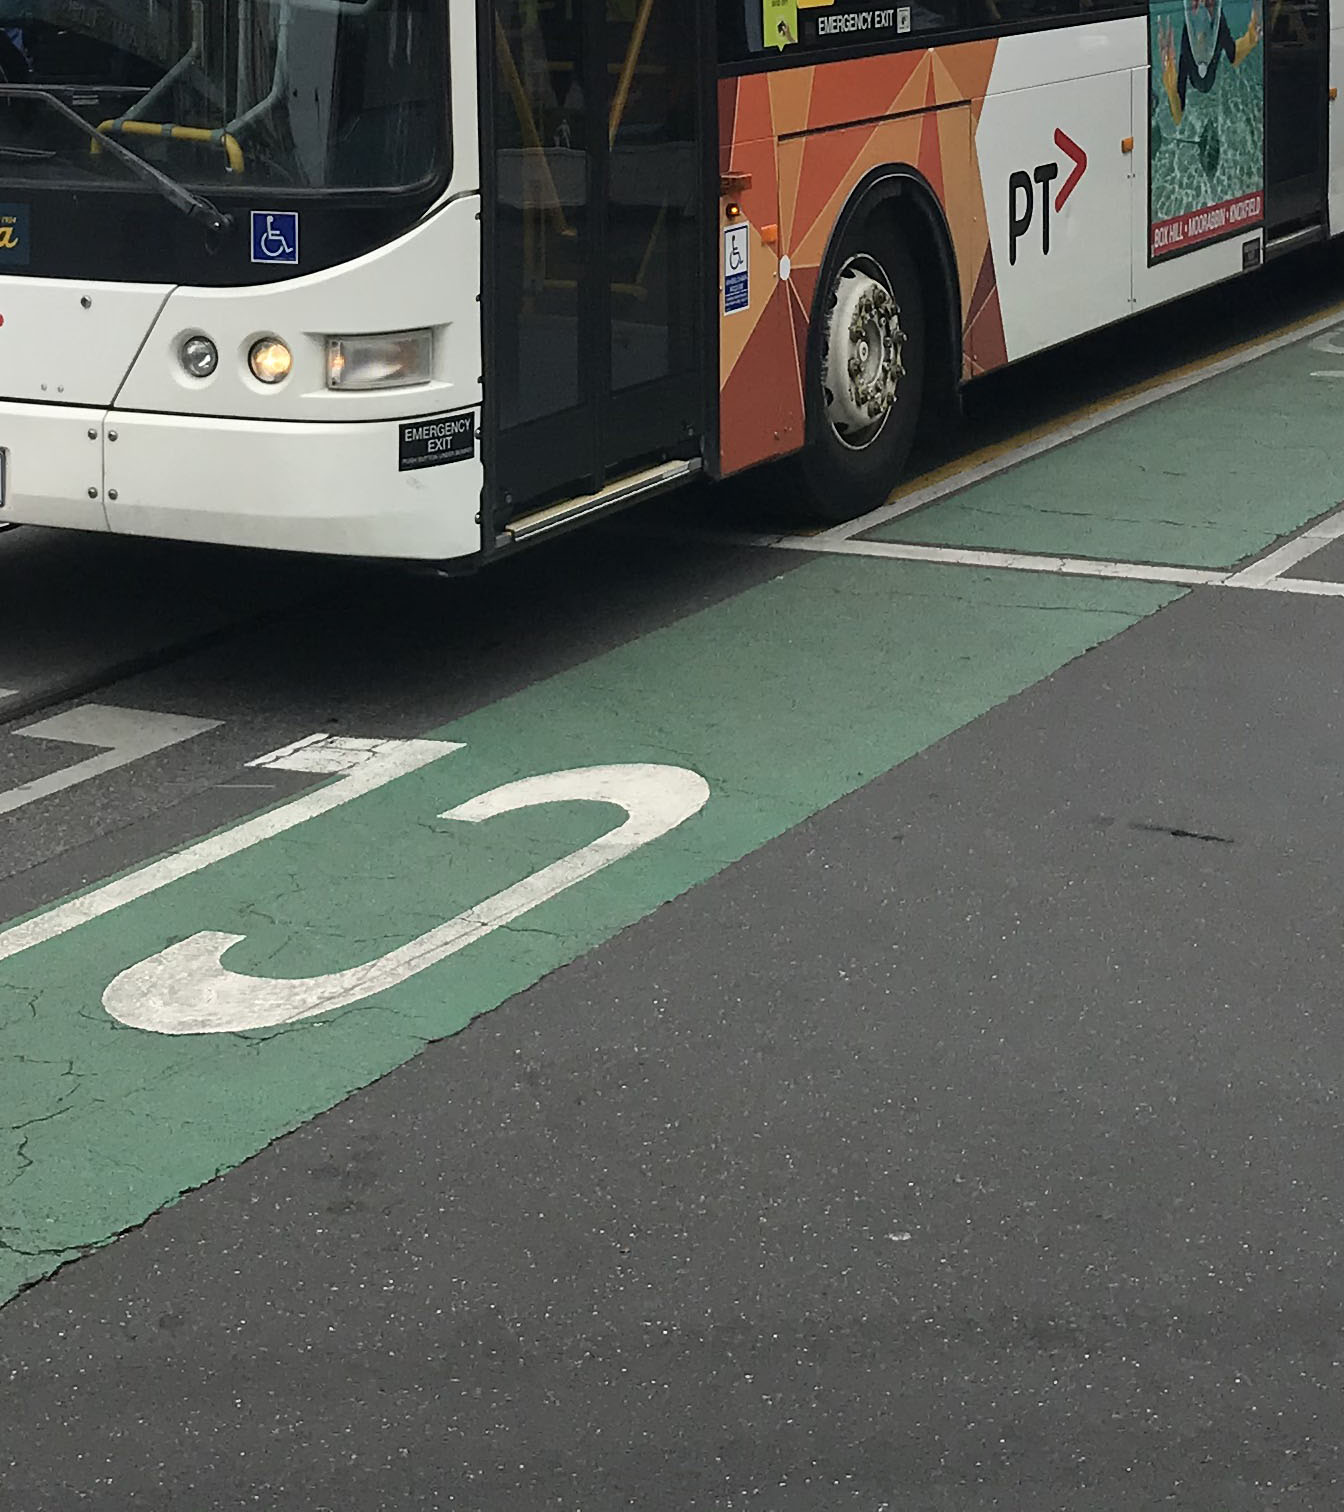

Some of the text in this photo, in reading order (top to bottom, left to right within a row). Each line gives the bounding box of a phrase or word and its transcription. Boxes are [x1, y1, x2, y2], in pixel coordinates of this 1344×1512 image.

[818, 9, 894, 35] EMERGENCY EXIT
[1009, 162, 1058, 266] PT
[1154, 228, 1168, 248] BOX
[1169, 221, 1184, 245] HILL
[404, 418, 472, 442] EMERGENCY
[427, 436, 453, 453] EXIT
